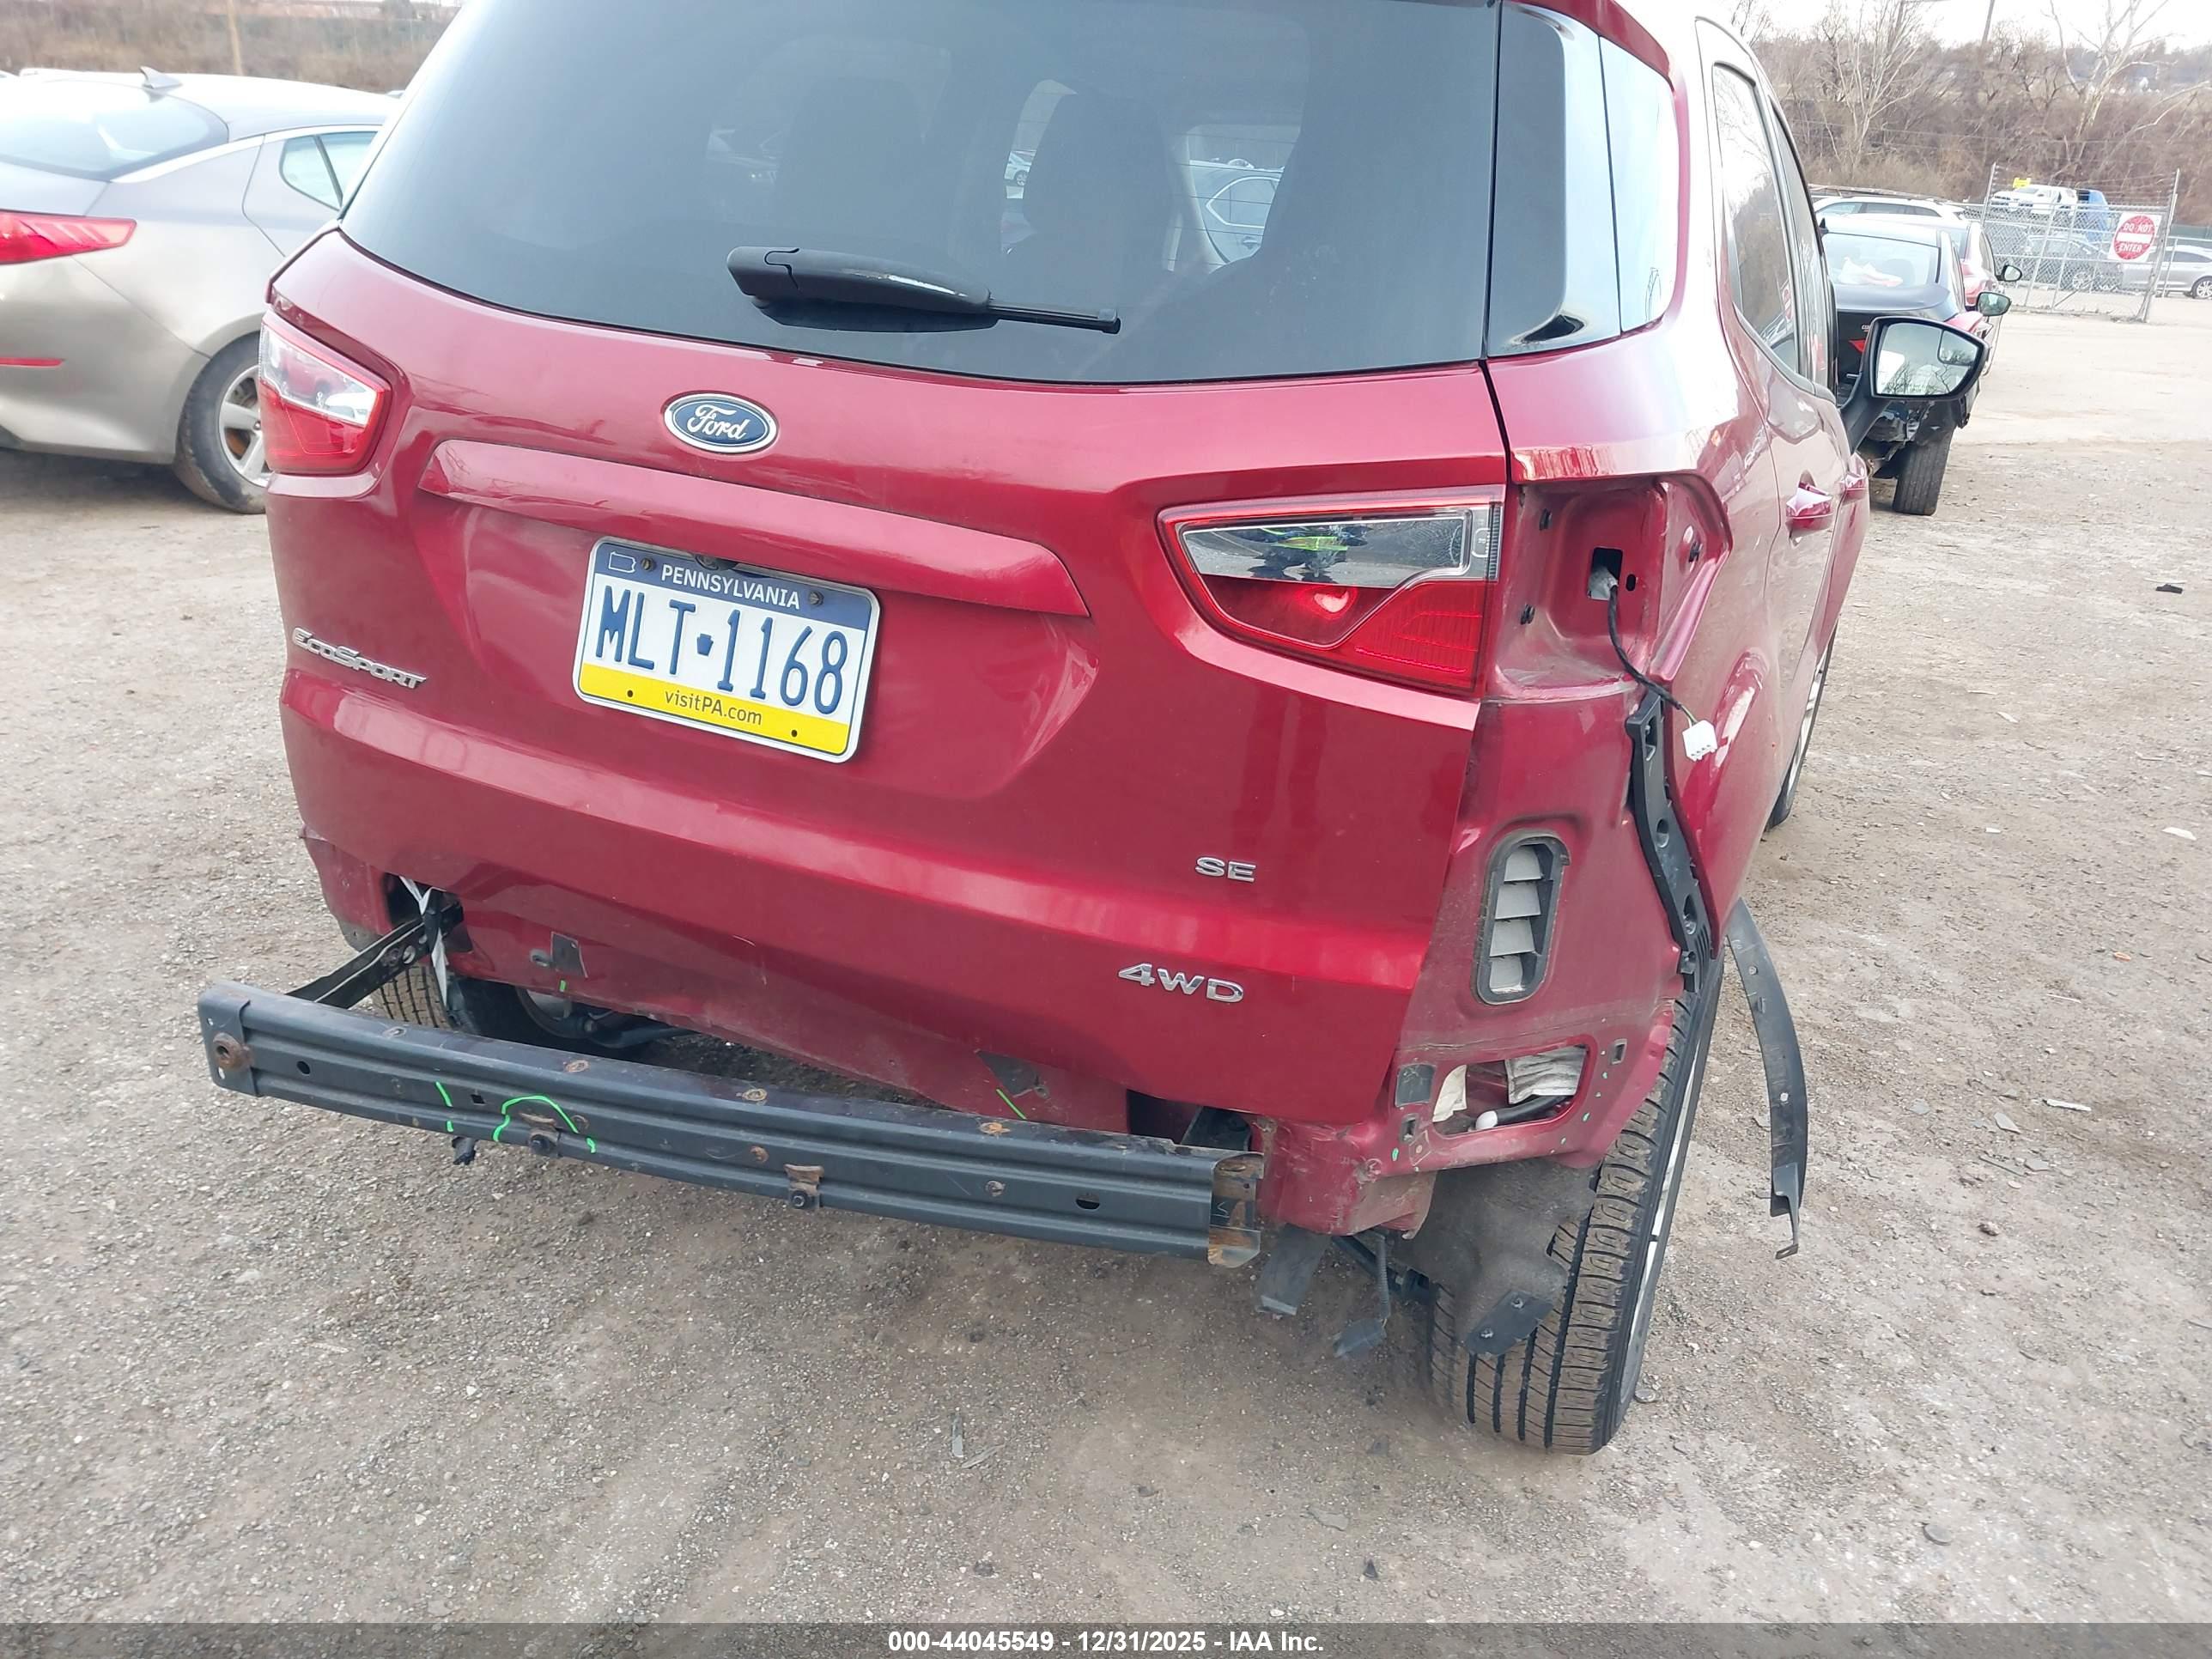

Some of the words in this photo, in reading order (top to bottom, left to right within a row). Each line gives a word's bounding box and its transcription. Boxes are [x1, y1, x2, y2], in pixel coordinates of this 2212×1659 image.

[2123, 222, 2136, 233] DO
[2137, 222, 2154, 234] NOT
[2118, 242, 2143, 252] ENTER
[687, 404, 751, 440] Ford
[661, 563, 800, 610] PENNSYLVANIA
[665, 688, 763, 726] visitPA.com
[1194, 856, 1256, 883] SE
[1118, 963, 1244, 1003] 4WD
